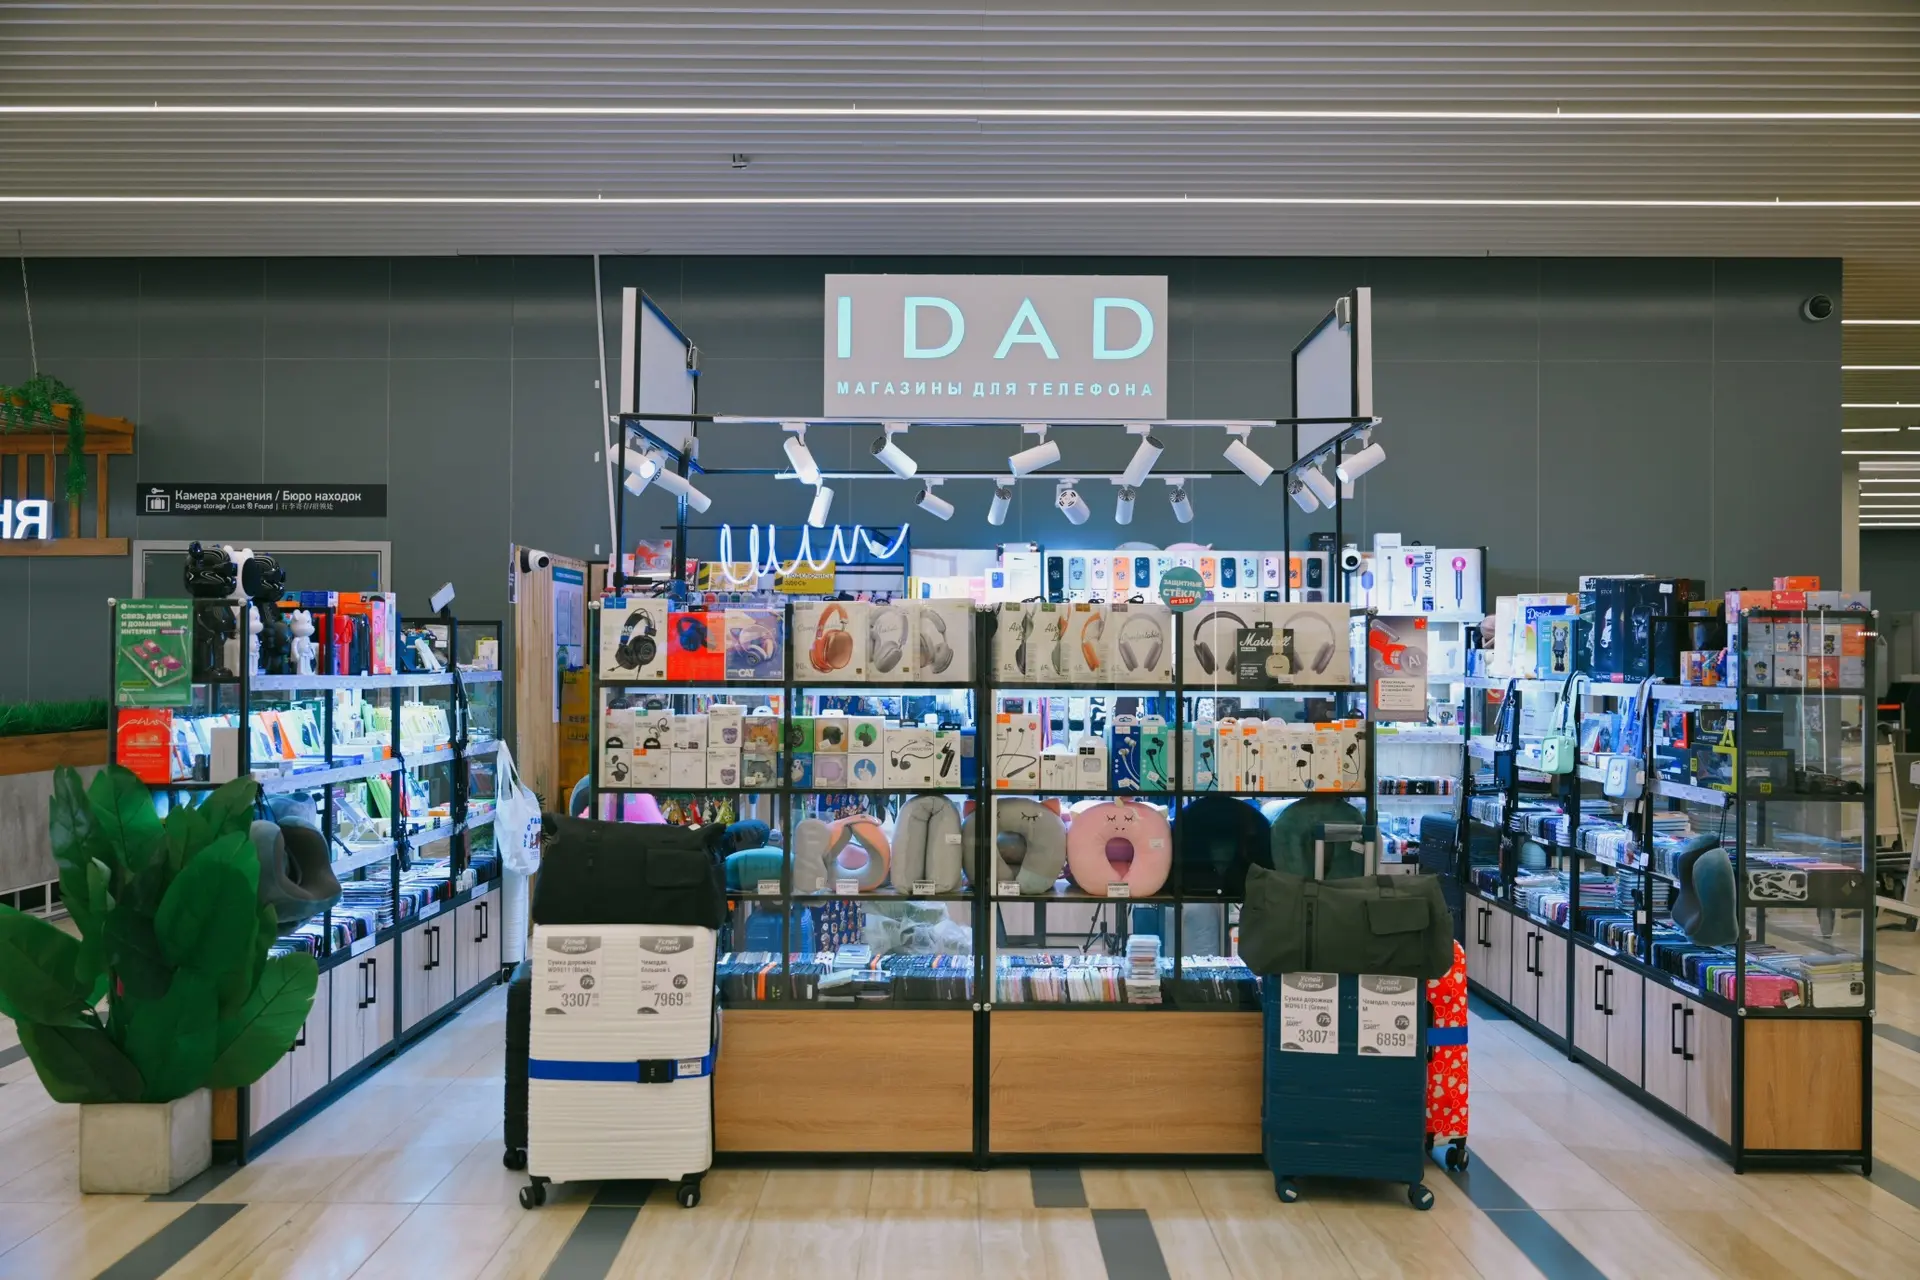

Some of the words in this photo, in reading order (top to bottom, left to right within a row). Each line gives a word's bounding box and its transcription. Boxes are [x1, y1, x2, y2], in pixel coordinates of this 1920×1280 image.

[837, 296, 1154, 360] IDAD
[837, 381, 962, 395] МАГАЗИНЫ
[972, 382, 1017, 398] ДЛЯ
[1028, 383, 1153, 397] ТЕЛЕФОНА
[175, 490, 217, 503] Камера
[220, 492, 272, 503] хранения
[283, 490, 312, 503] Бюро
[315, 492, 361, 502] находок
[175, 502, 201, 510] Baggage
[1163, 579, 1203, 587] ЗАЩИТНЫЕ
[1423, 566, 1433, 588] Dryer
[1162, 588, 1202, 599] СТЁКЛА
[1239, 632, 1292, 647] Marshll
[1408, 654, 1421, 668] AI
[738, 668, 755, 677] CAT
[561, 992, 591, 1007] 3307
[654, 992, 683, 1007] 7969
[1298, 1029, 1328, 1044] 3307
[1376, 1032, 1406, 1047] 6859
